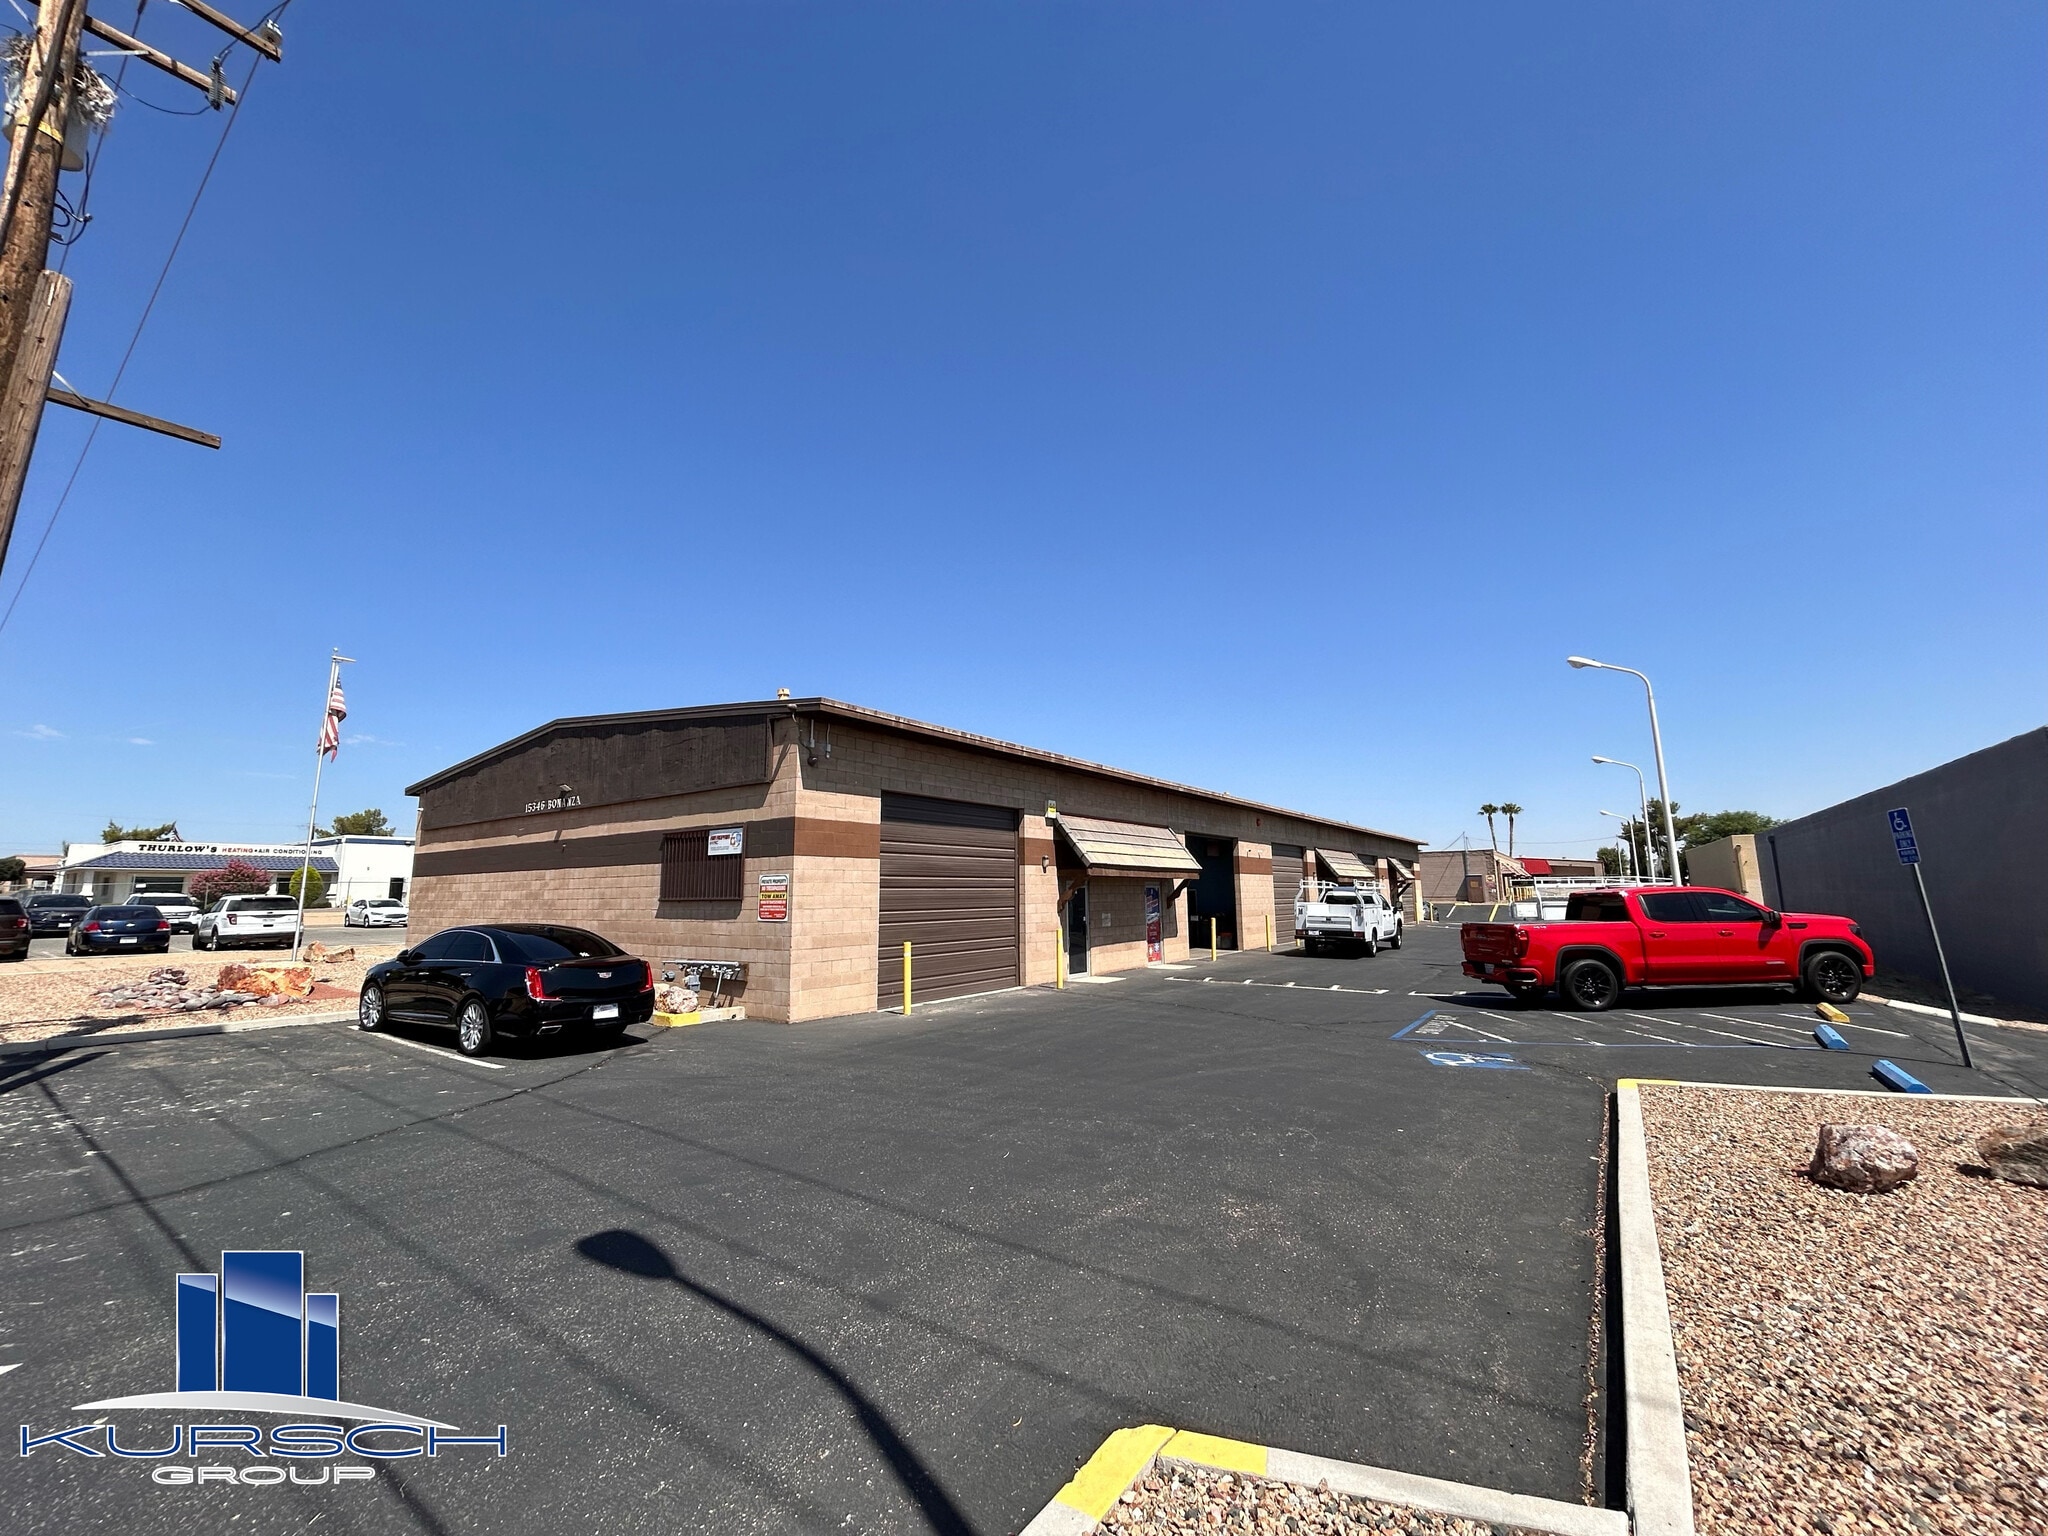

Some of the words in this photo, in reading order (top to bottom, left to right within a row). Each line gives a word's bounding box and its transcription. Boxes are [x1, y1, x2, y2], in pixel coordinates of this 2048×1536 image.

[525, 800, 546, 812] 15346
[547, 795, 581, 809] BONANZA
[138, 844, 218, 853] THURLOW'S
